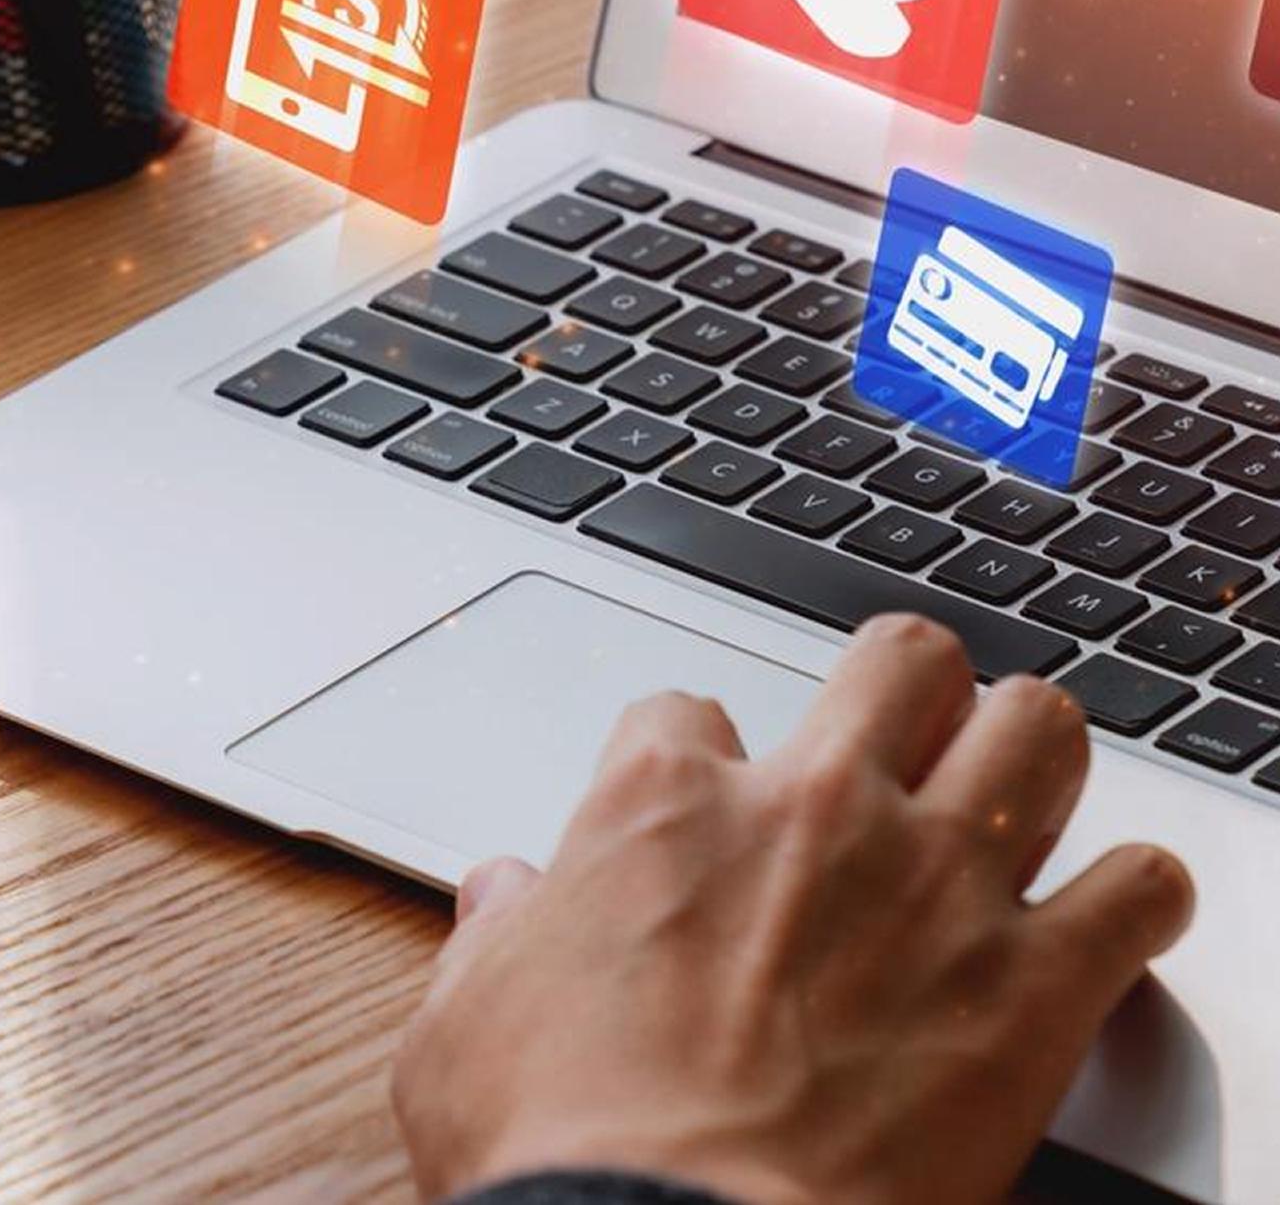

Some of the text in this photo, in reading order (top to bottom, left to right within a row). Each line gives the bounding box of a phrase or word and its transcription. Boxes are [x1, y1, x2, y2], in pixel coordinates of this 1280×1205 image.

[610, 294, 637, 311] Q
[797, 306, 820, 320] 3
[695, 322, 727, 340] W
[561, 343, 586, 357] A
[783, 355, 809, 371] E
[649, 372, 674, 387] S
[533, 397, 563, 414] Z
[733, 403, 761, 418] D
[620, 429, 649, 447] X
[825, 435, 851, 449] F
[1153, 429, 1176, 442] 7
[711, 462, 737, 478] C
[914, 468, 941, 483] G
[1243, 462, 1266, 475] 8
[1140, 480, 1169, 496] U
[803, 493, 828, 508] V
[1001, 499, 1033, 517] H
[889, 527, 914, 542] B
[1096, 535, 1121, 548] J
[977, 559, 1009, 577] N
[1187, 566, 1215, 583] K
[1067, 593, 1102, 612] M
